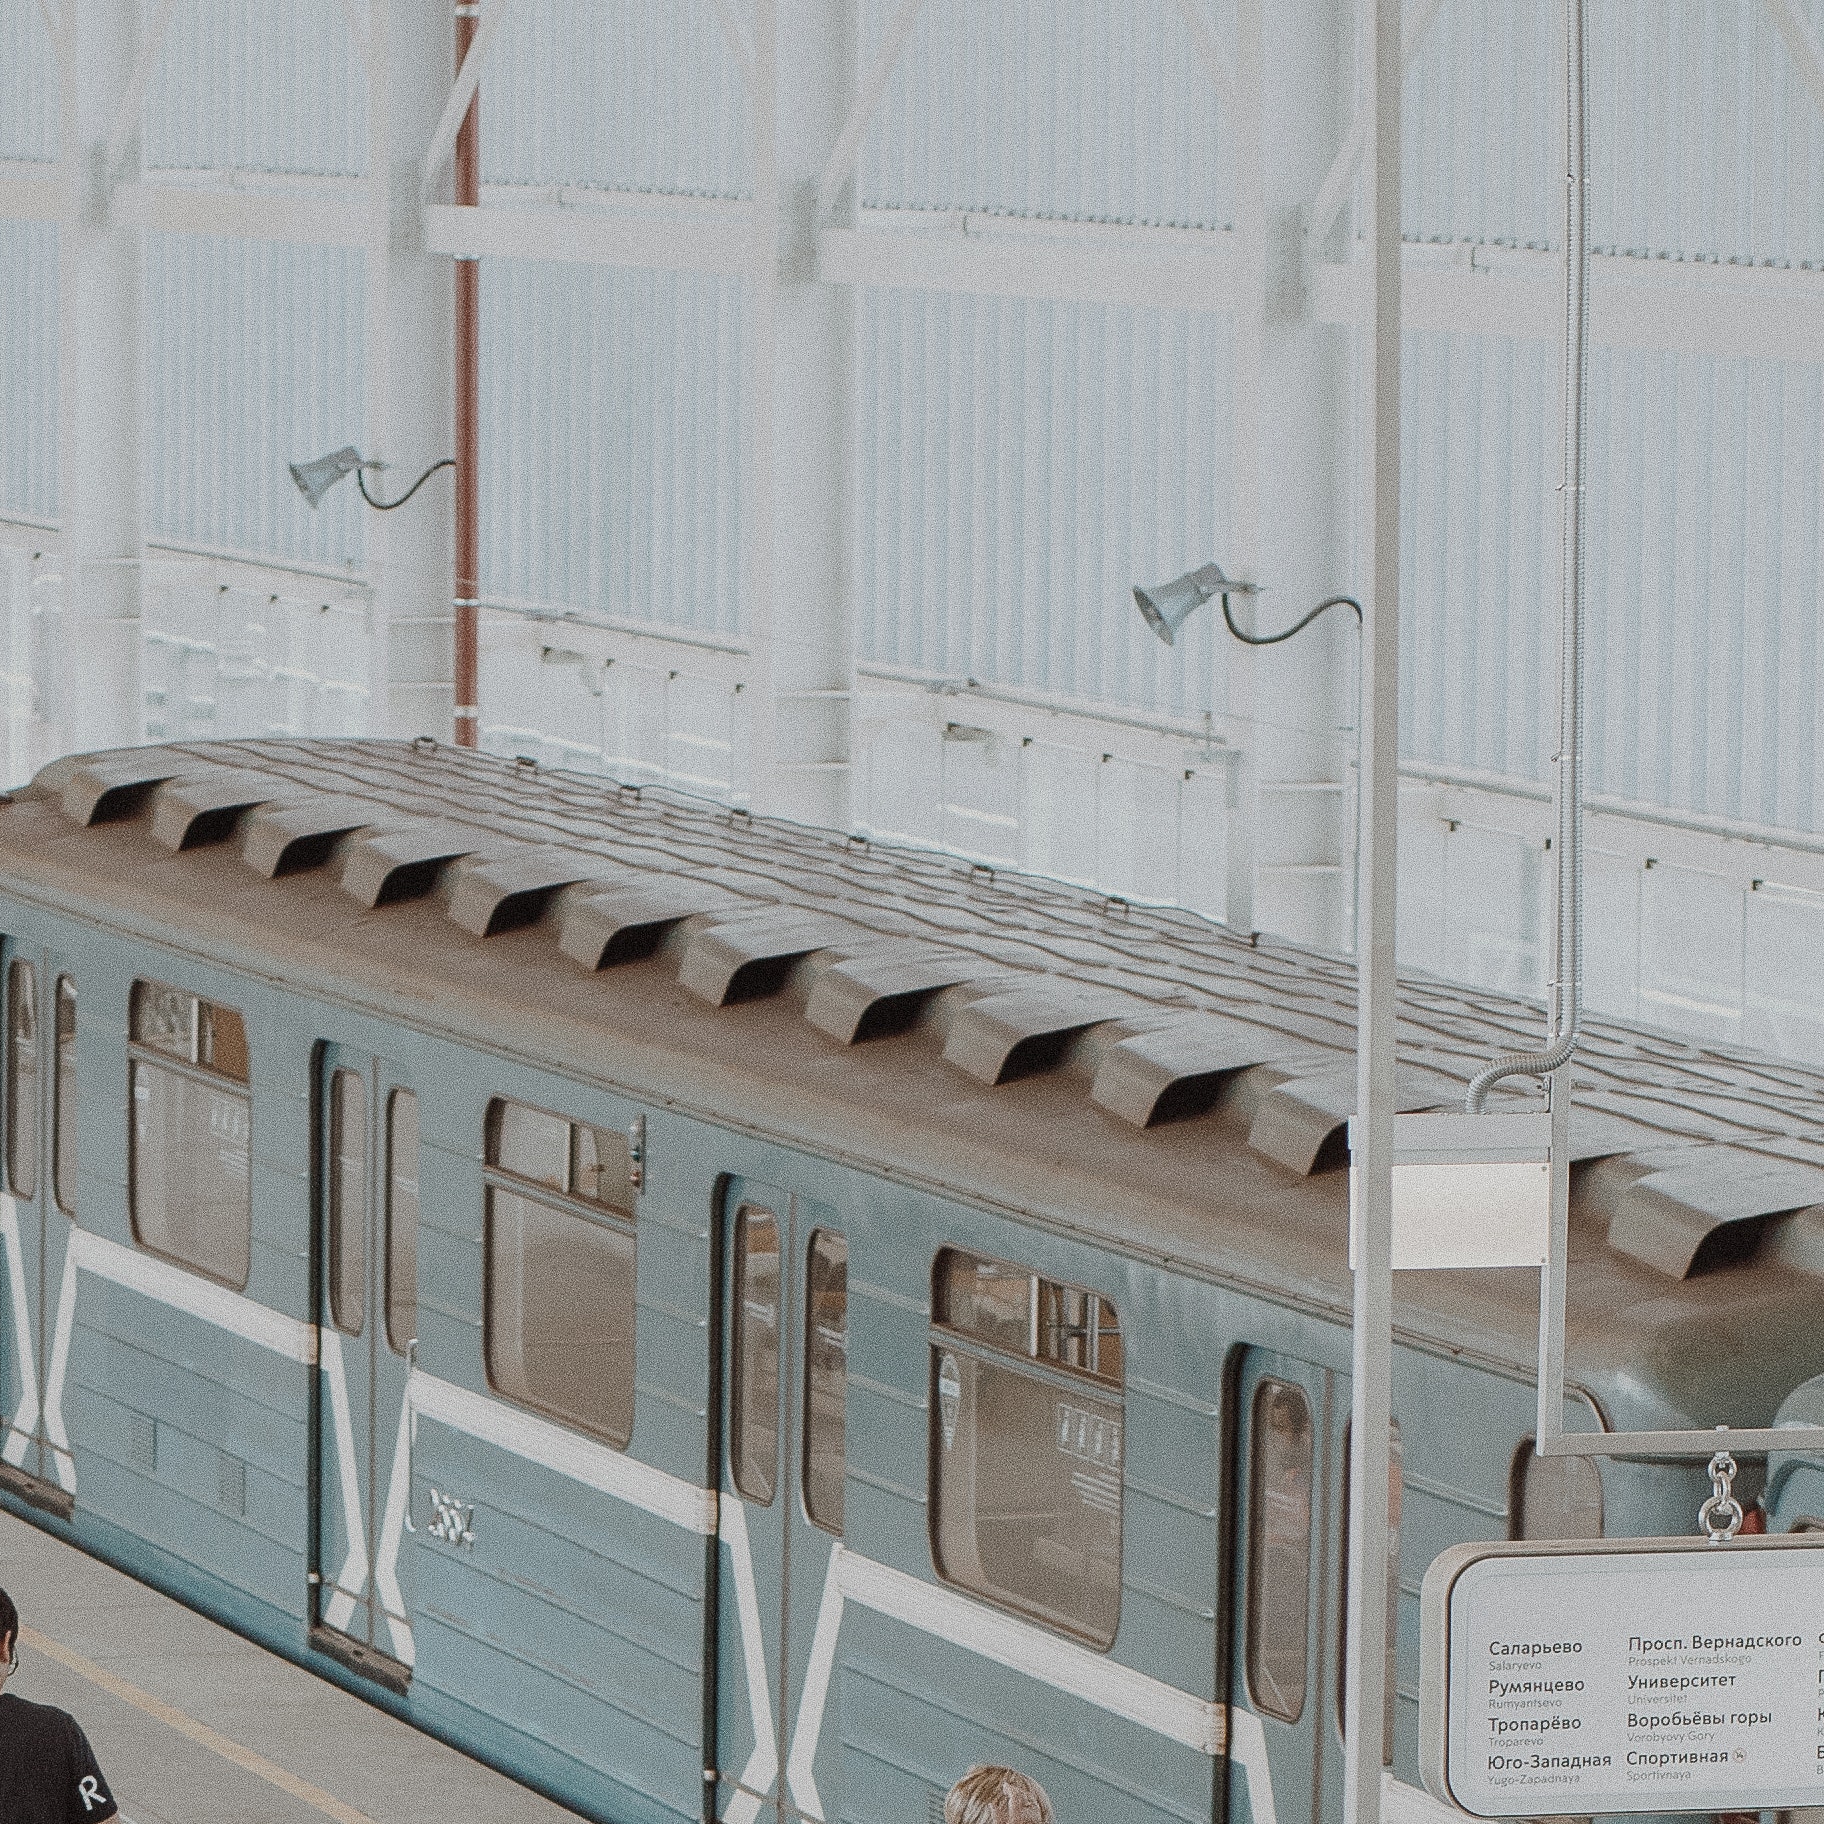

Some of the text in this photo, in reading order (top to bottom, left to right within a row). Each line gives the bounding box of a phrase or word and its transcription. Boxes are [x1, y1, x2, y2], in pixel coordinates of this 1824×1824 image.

[1488, 1640, 1583, 1658] Саларьево
[1628, 1634, 1803, 1655] Просп. Вернадского
[1490, 1660, 1542, 1672] Salaryevo
[1488, 1678, 1585, 1698] Румянцево
[1627, 1675, 1736, 1691] Университет
[1487, 1715, 1582, 1735] Тропарёво
[1627, 1710, 1773, 1730] Воробьёвы горы
[1487, 1753, 1612, 1771] Юго-Западная
[1625, 1750, 1729, 1768] Спортивная
[78, 1775, 107, 1811] R
